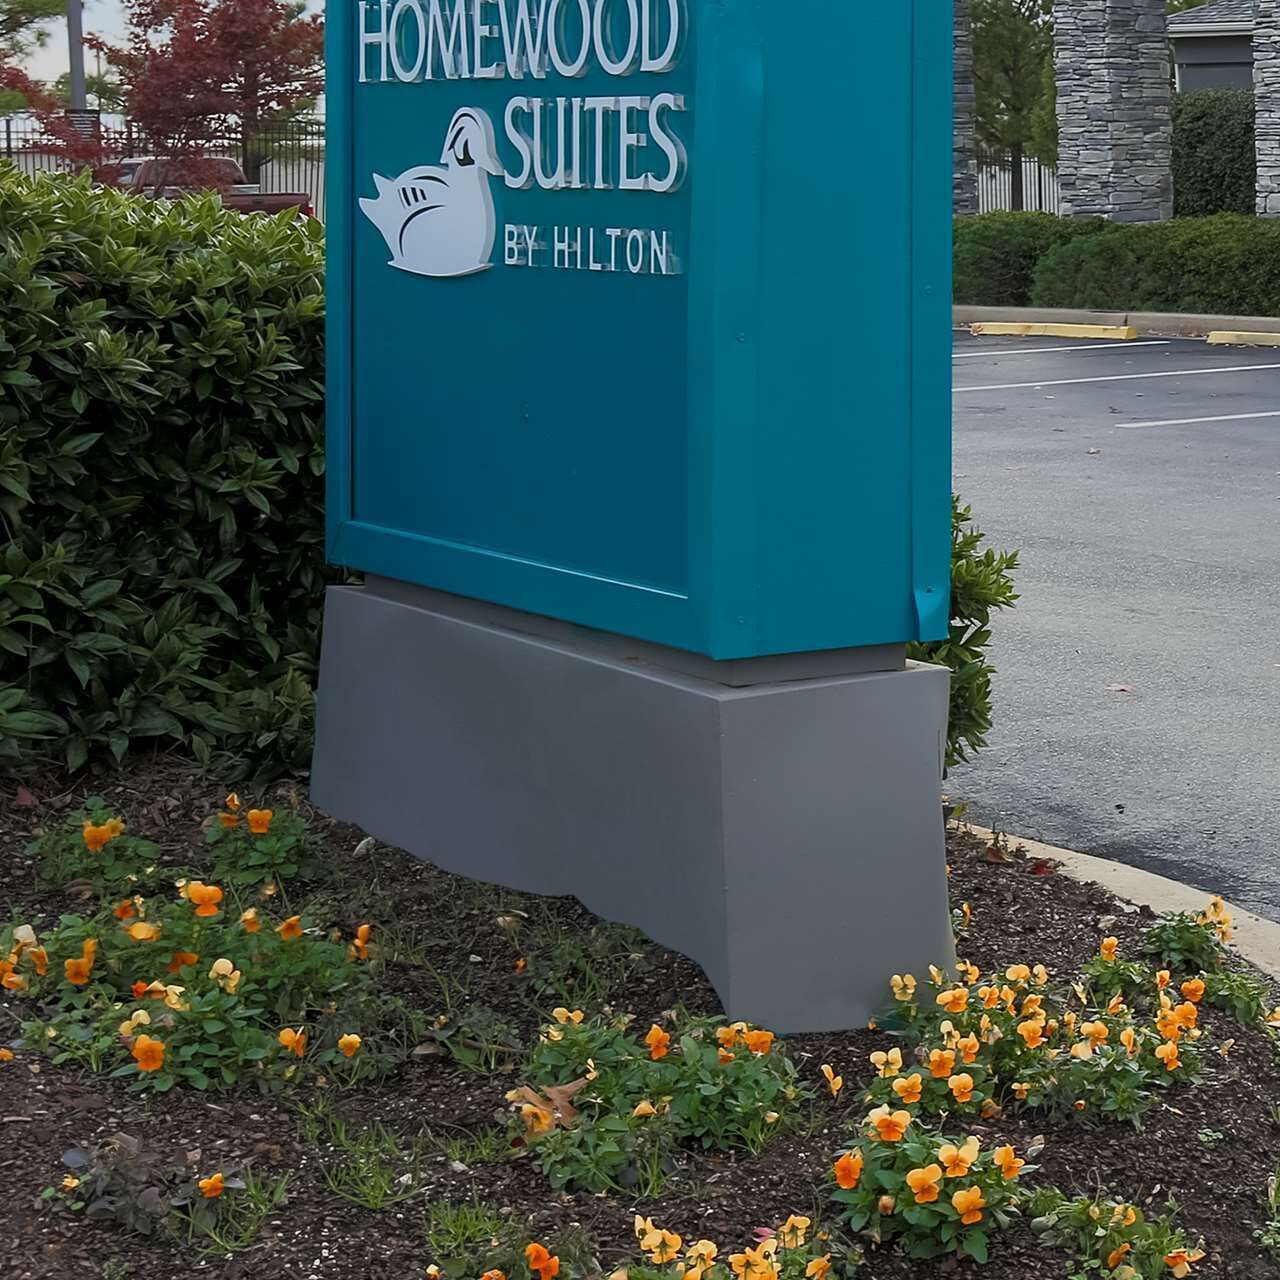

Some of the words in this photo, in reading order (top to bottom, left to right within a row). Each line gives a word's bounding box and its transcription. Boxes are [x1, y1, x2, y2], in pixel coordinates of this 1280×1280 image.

[504, 93, 682, 192] SUITES
[505, 224, 538, 267] BY
[554, 226, 670, 275] HILTON
